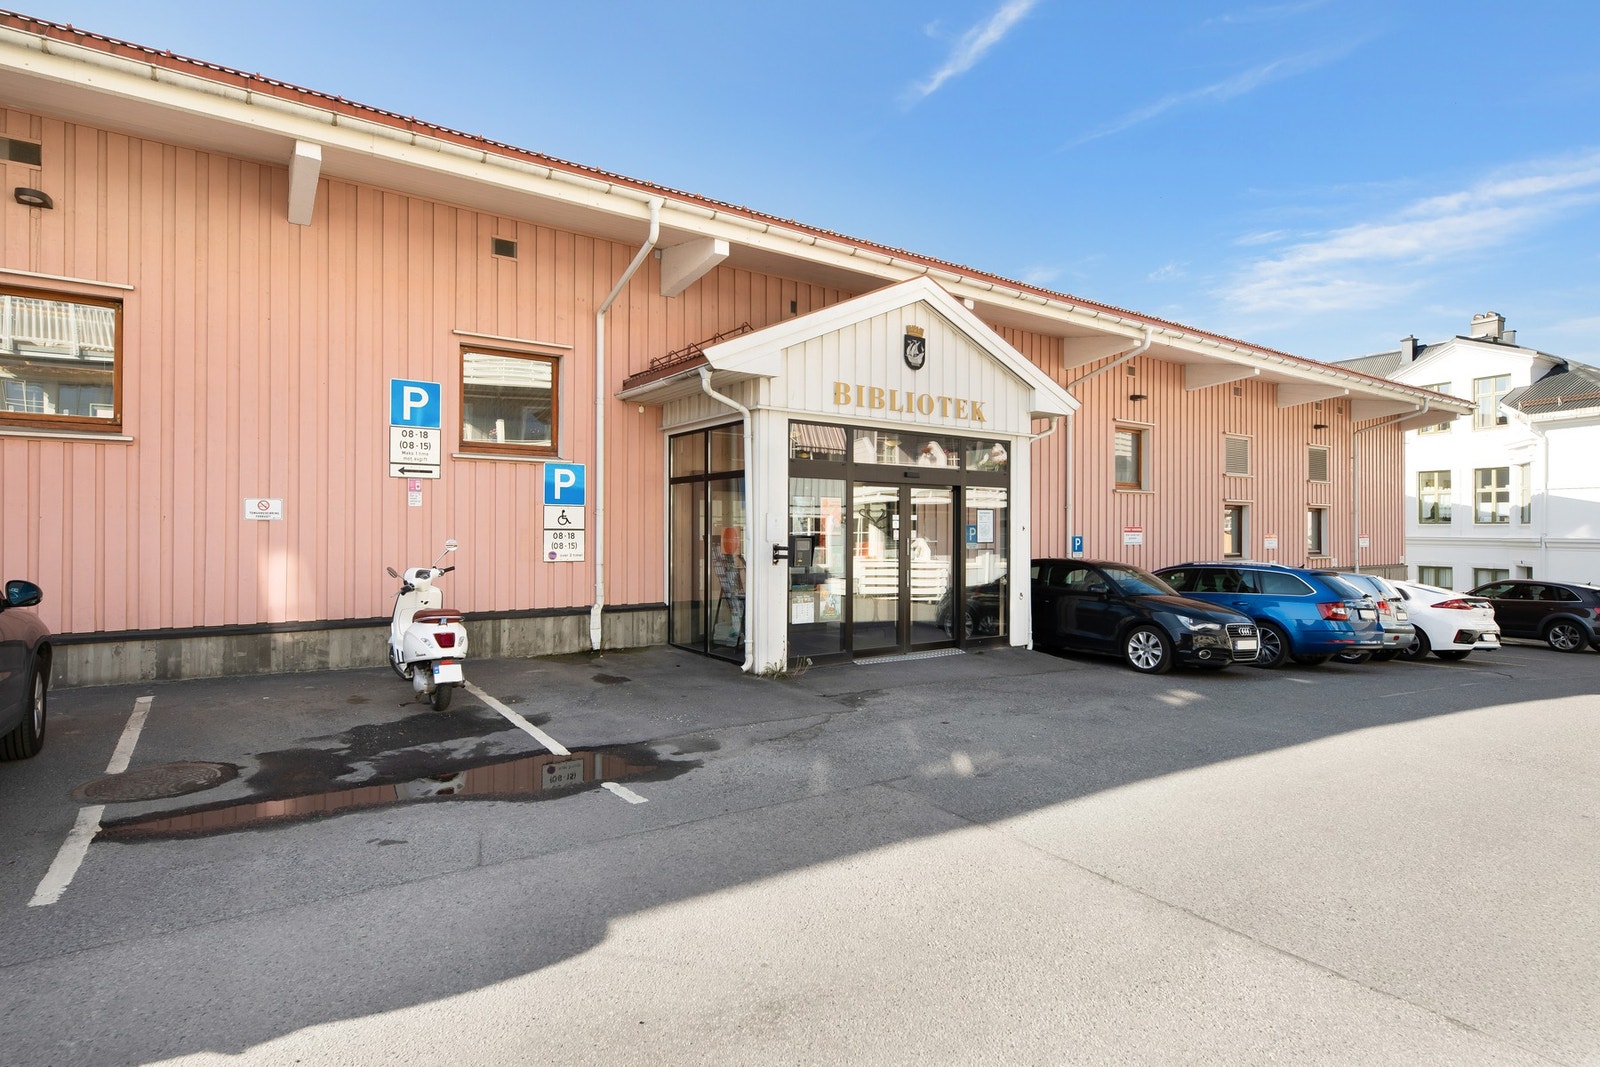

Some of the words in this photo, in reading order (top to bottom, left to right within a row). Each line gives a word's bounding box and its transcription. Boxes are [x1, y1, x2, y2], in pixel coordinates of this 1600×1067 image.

[403, 386, 429, 420] P
[833, 381, 988, 423] BIBLIOTEK
[554, 468, 576, 499] P
[969, 527, 976, 541] P
[1075, 538, 1081, 550] P
